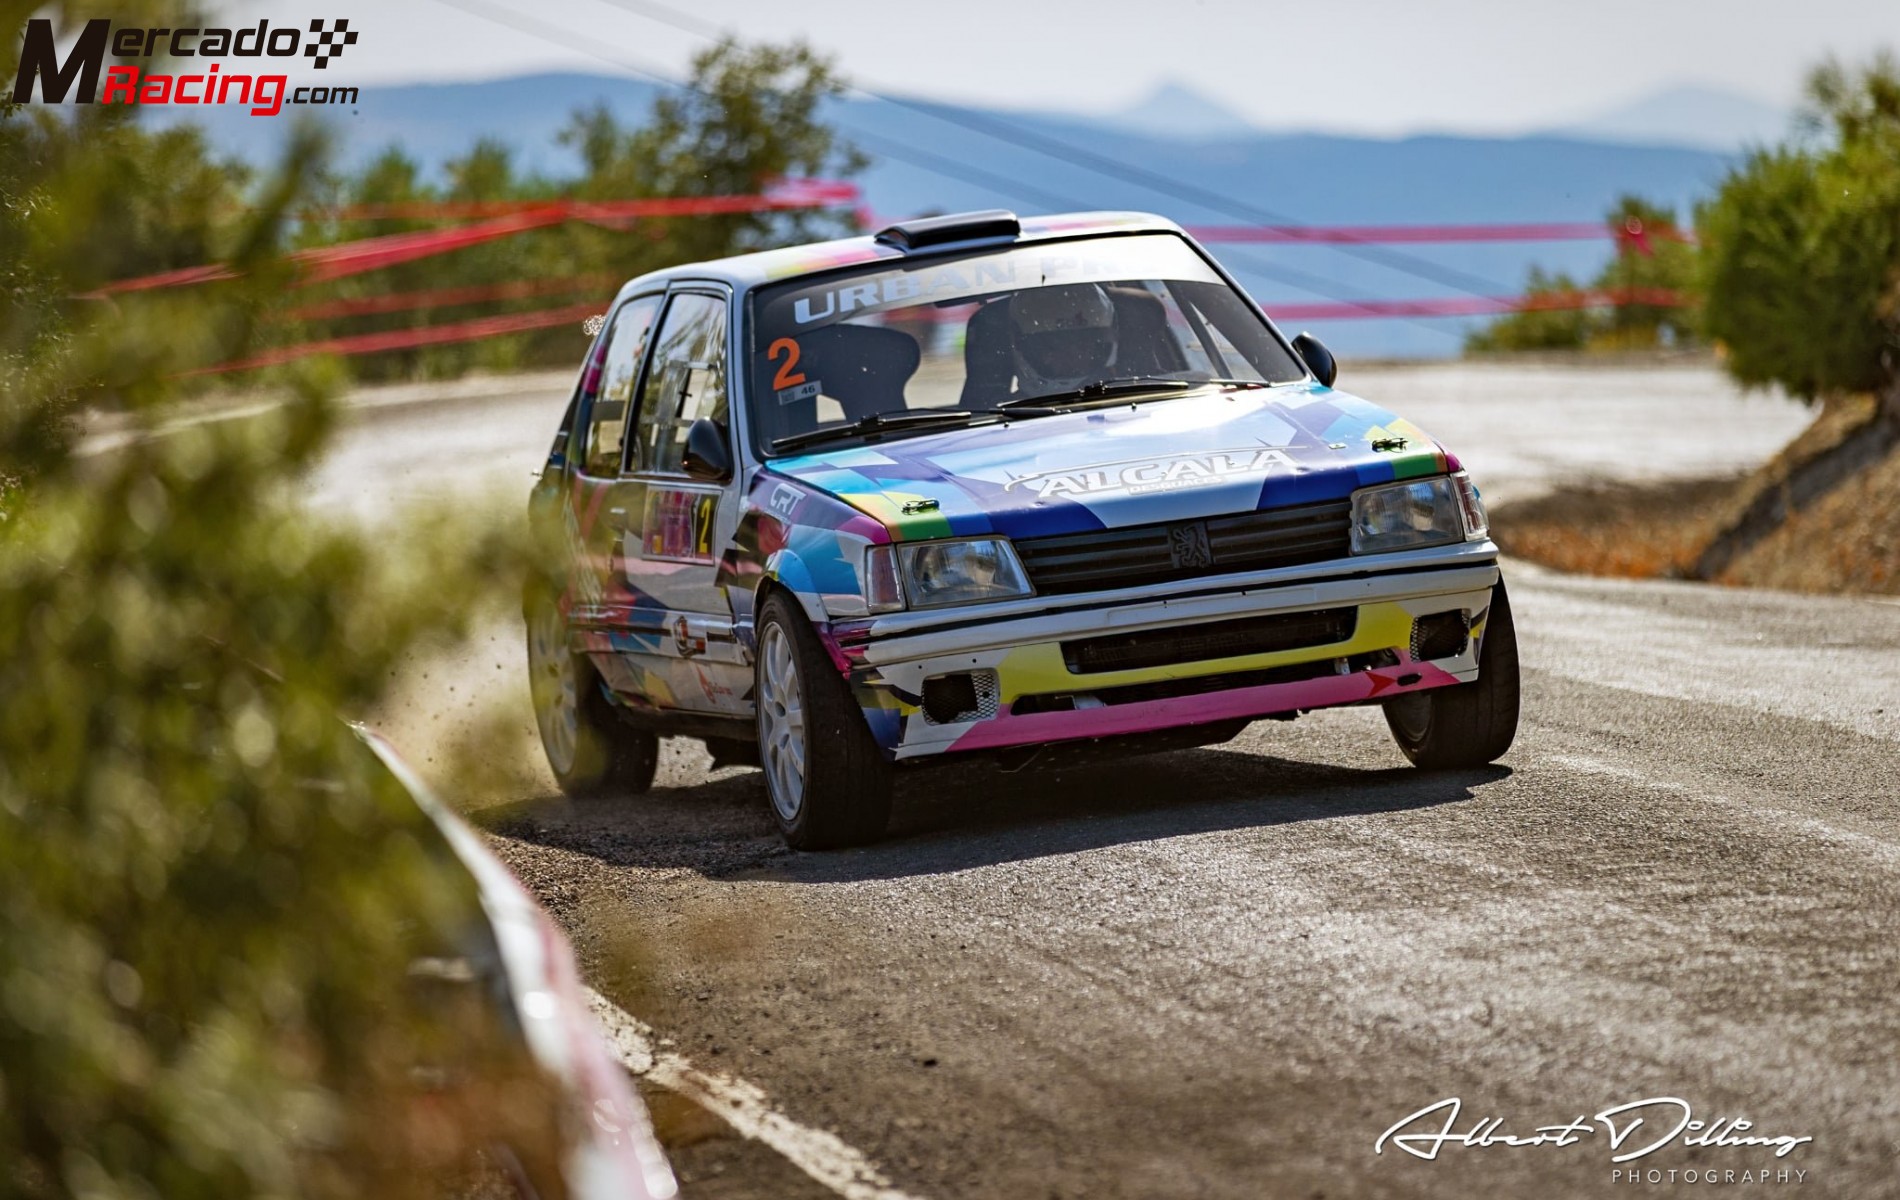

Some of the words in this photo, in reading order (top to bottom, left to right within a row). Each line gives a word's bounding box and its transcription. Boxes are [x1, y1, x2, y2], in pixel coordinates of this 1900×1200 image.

[794, 259, 1015, 324] URBAN
[1039, 255, 1156, 286] PR
[768, 337, 806, 392] 2
[801, 384, 816, 395] 46
[1038, 448, 1302, 498] ALCALA
[699, 498, 711, 554] 2
